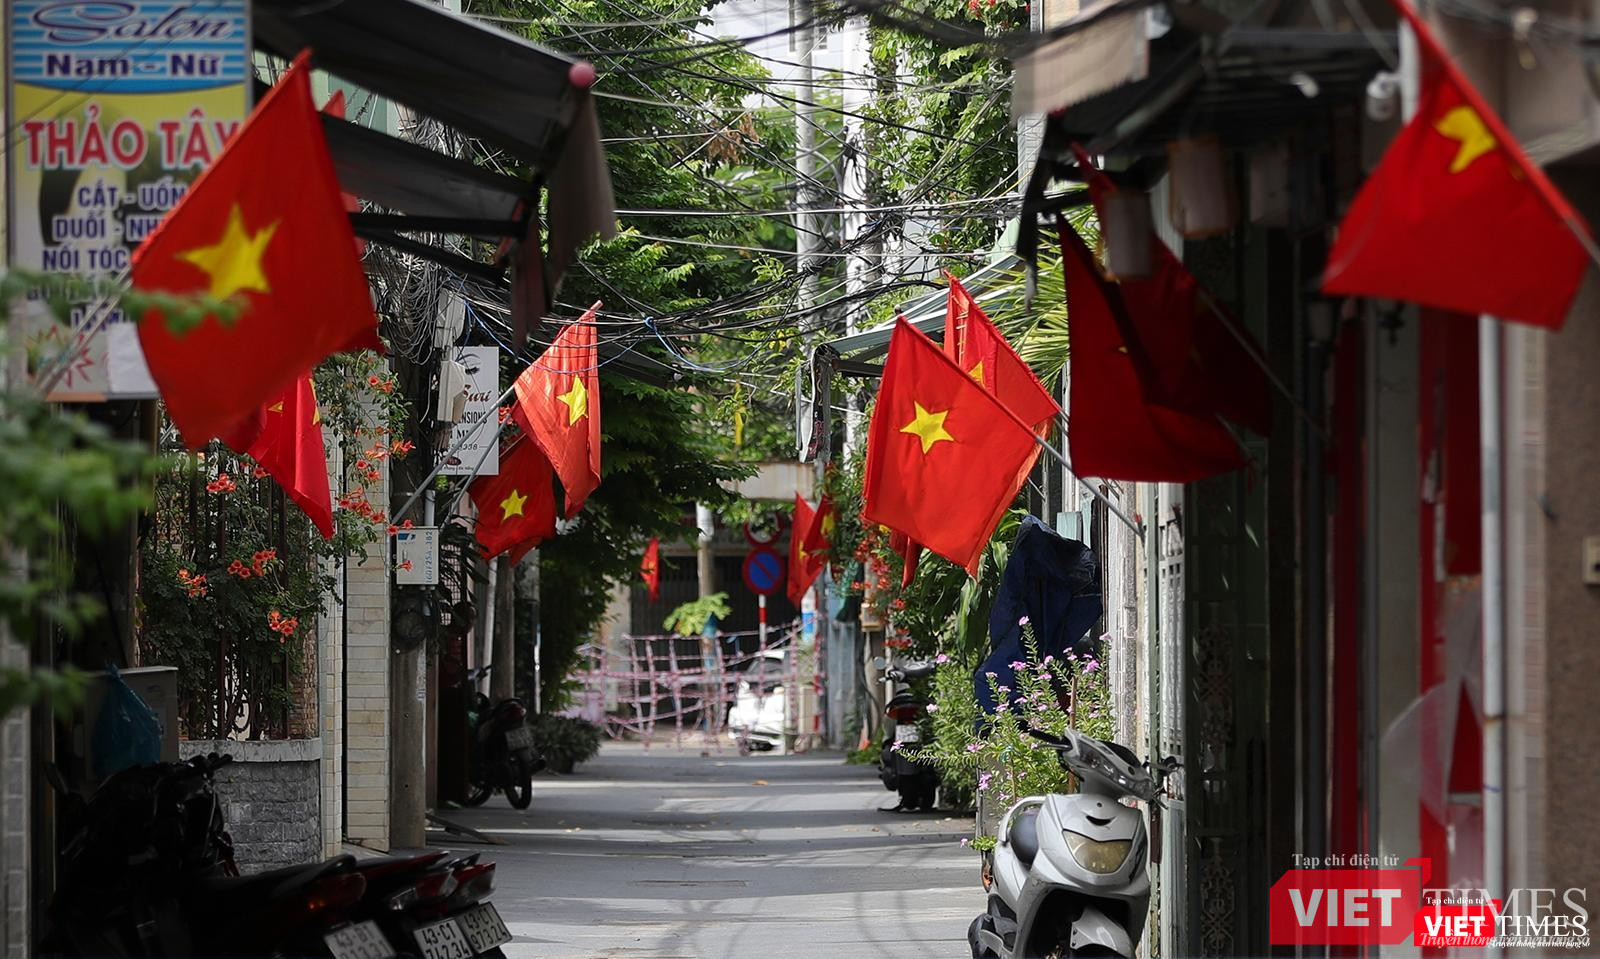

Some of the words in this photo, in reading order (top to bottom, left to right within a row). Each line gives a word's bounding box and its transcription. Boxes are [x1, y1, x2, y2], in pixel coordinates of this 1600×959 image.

[33, 2, 228, 42] Salon
[46, 54, 129, 76] Nam
[25, 104, 145, 165] THẢO
[78, 178, 118, 207] CẮT
[43, 244, 80, 271] NỐI
[88, 244, 128, 270] TÓC
